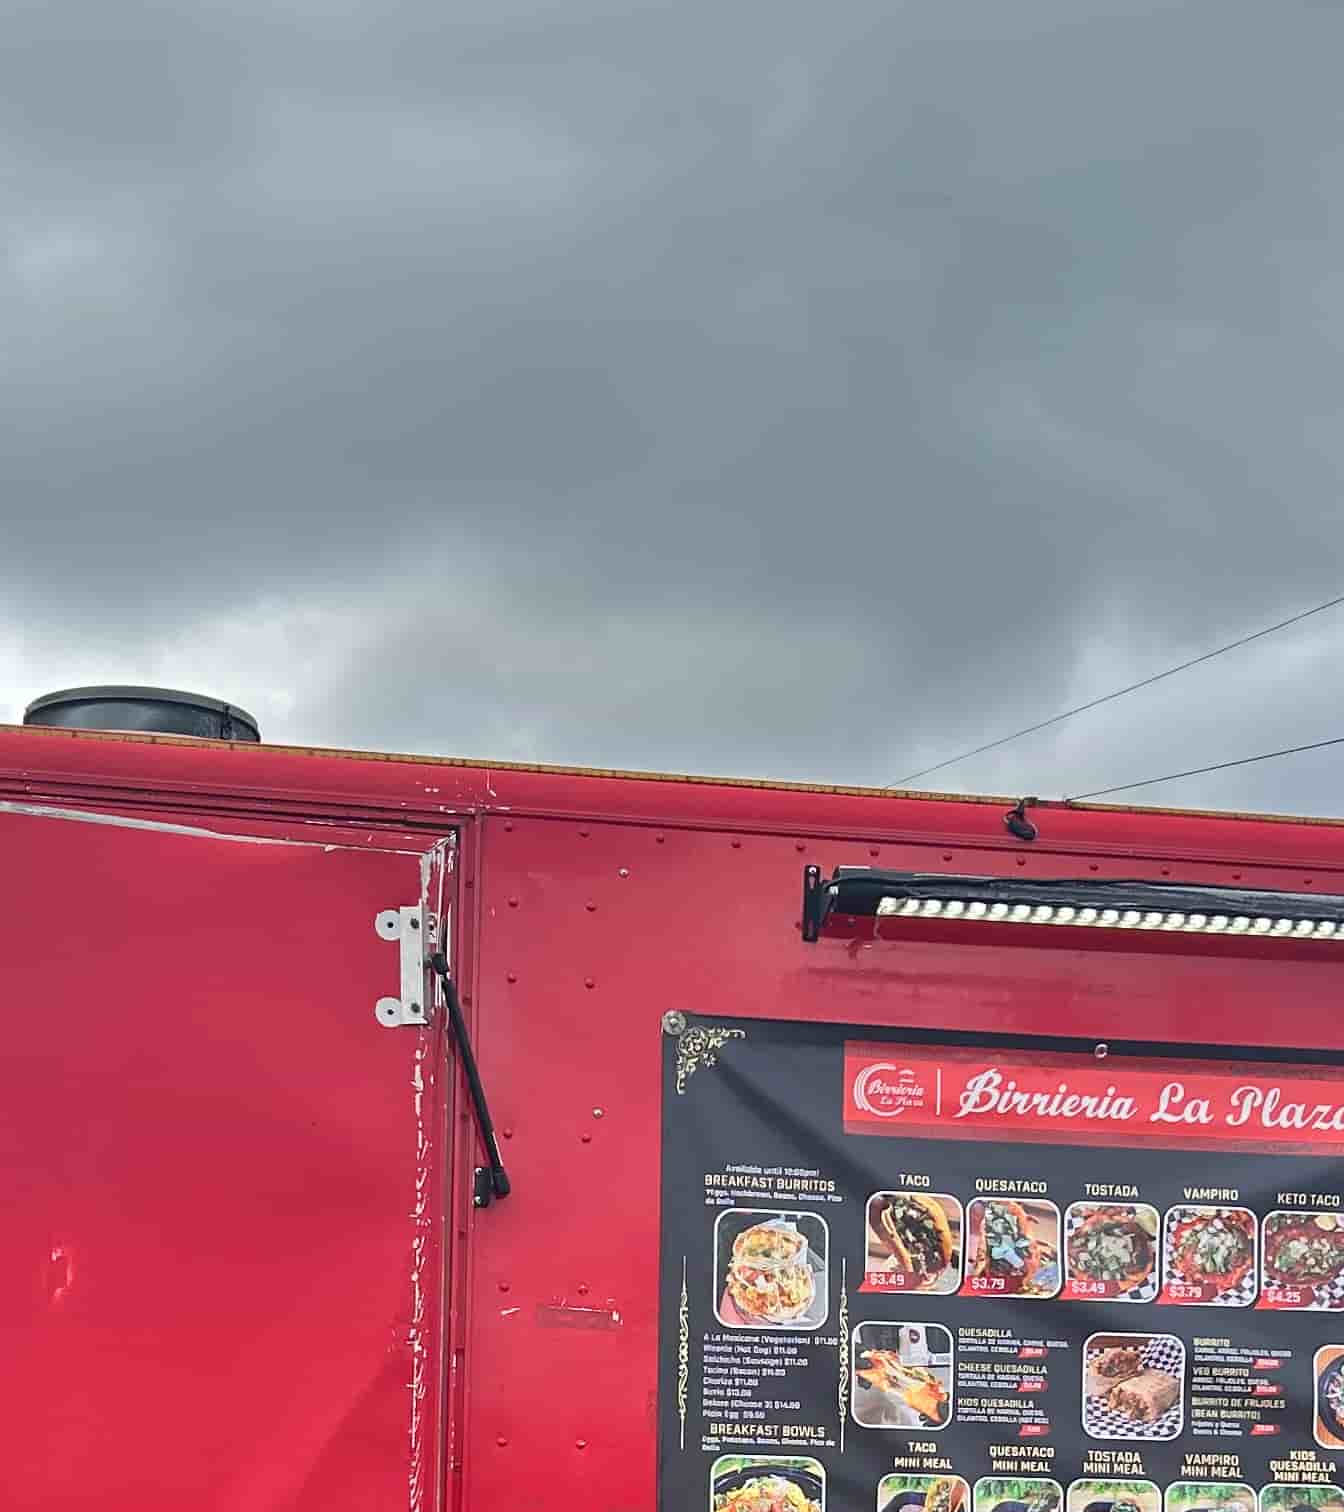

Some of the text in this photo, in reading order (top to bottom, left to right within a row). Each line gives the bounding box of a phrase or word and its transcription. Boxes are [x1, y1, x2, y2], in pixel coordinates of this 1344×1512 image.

[953, 1068, 1137, 1120] Birrieria
[1150, 1082, 1214, 1124] La
[705, 1174, 835, 1192] BREAKFAST BURRITOS
[900, 1174, 929, 1187] TACO
[975, 1179, 1047, 1193] QUESATACO
[1085, 1184, 1138, 1197] TOSTADA
[1184, 1188, 1238, 1201] VAMPIRO
[1278, 1193, 1340, 1207] KETO TACO
[870, 1274, 904, 1286] $3.49
[972, 1278, 1004, 1290] $3.79
[1071, 1281, 1105, 1294] $3.49
[1169, 1286, 1202, 1298] $3.79
[1267, 1291, 1300, 1303] $4.25
[959, 1328, 1012, 1338] QUESADILLA
[959, 1363, 1047, 1374] CHEESE QUESADILLA
[1212, 1368, 1249, 1376] BURRITO
[959, 1398, 1034, 1408] KIDS QUESADILLA
[711, 1423, 824, 1438] BREAKFAST BOWLS
[908, 1442, 936, 1453] TACO
[989, 1446, 1054, 1458] QUESATACO
[1088, 1450, 1140, 1463] TOSTADA
[1185, 1454, 1239, 1466] VAMPIRO
[1290, 1450, 1315, 1461] KIDS
[895, 1457, 952, 1469] MINI MEAL
[993, 1460, 1051, 1472] MINI MEAL
[1083, 1462, 1145, 1475] MINI MEAL
[1270, 1460, 1336, 1473] QUESADILLA
[1181, 1465, 1243, 1478] MINI MEAL
[1274, 1472, 1331, 1483] MINI MEAL
